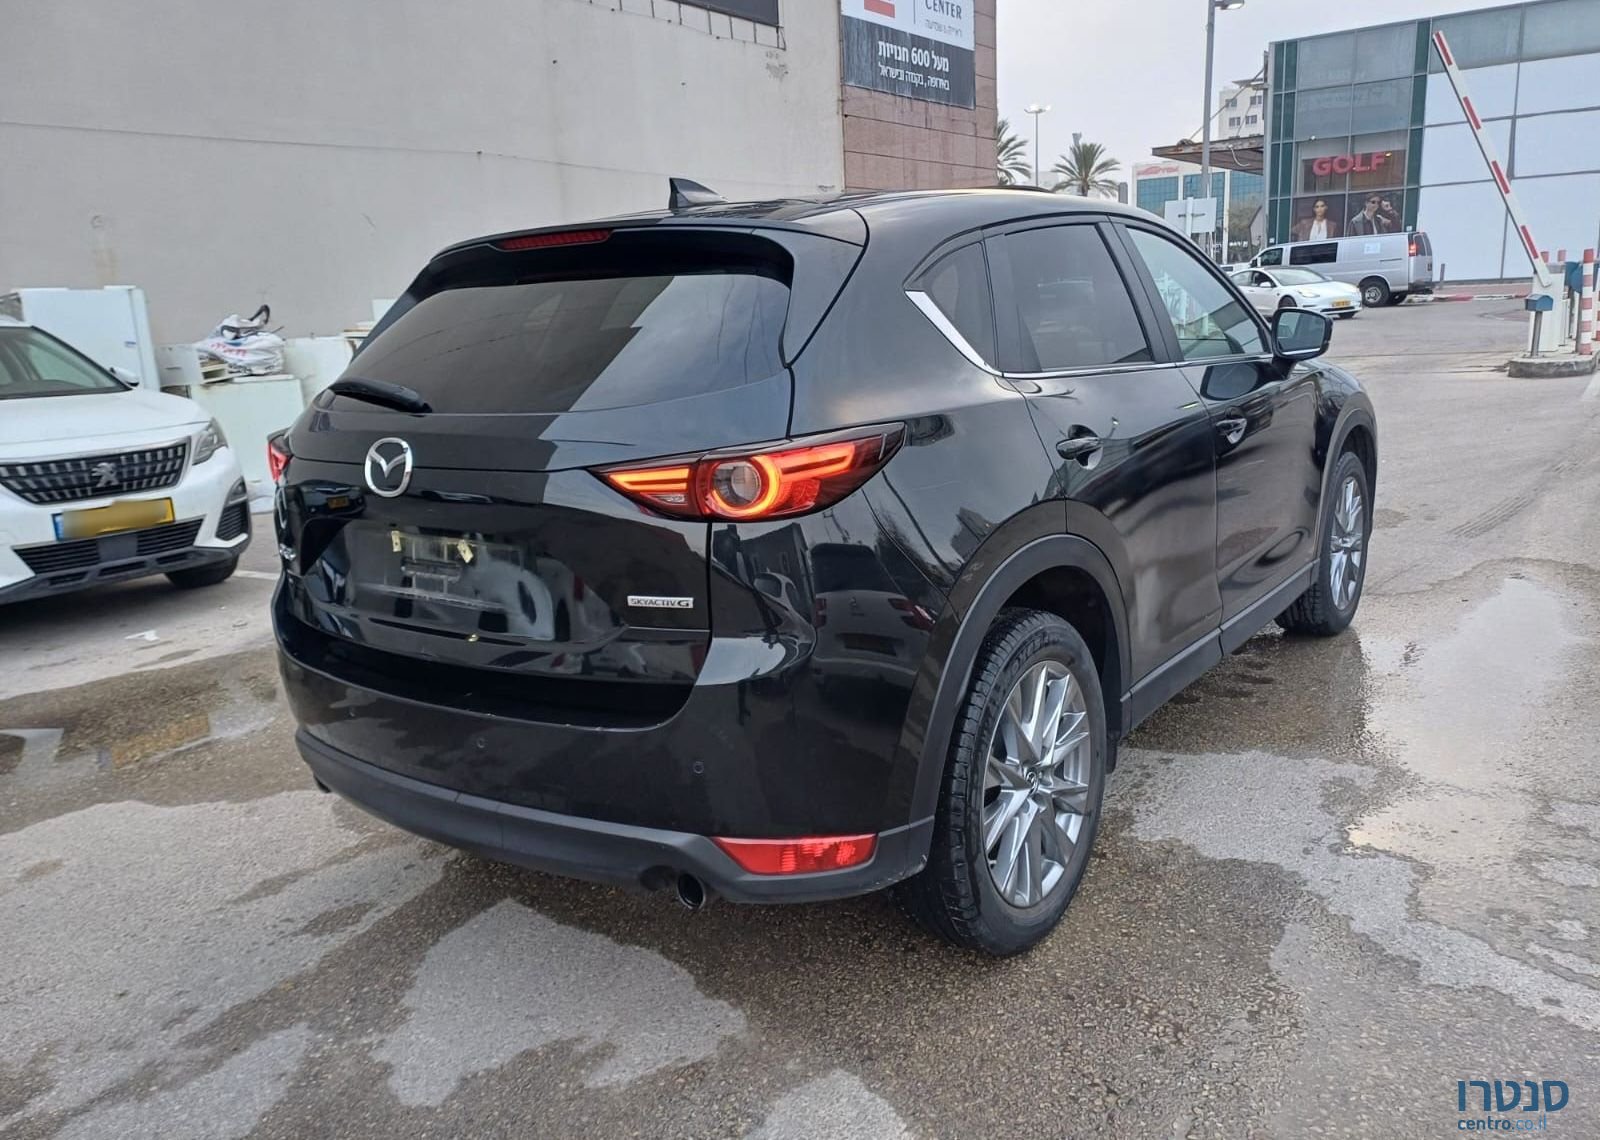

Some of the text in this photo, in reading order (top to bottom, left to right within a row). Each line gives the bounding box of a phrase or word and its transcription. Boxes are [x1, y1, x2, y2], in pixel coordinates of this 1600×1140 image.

[925, 0, 962, 20] CENTER
[878, 40, 949, 73] מעל 600 חנויות
[1312, 152, 1385, 176] GOLF
